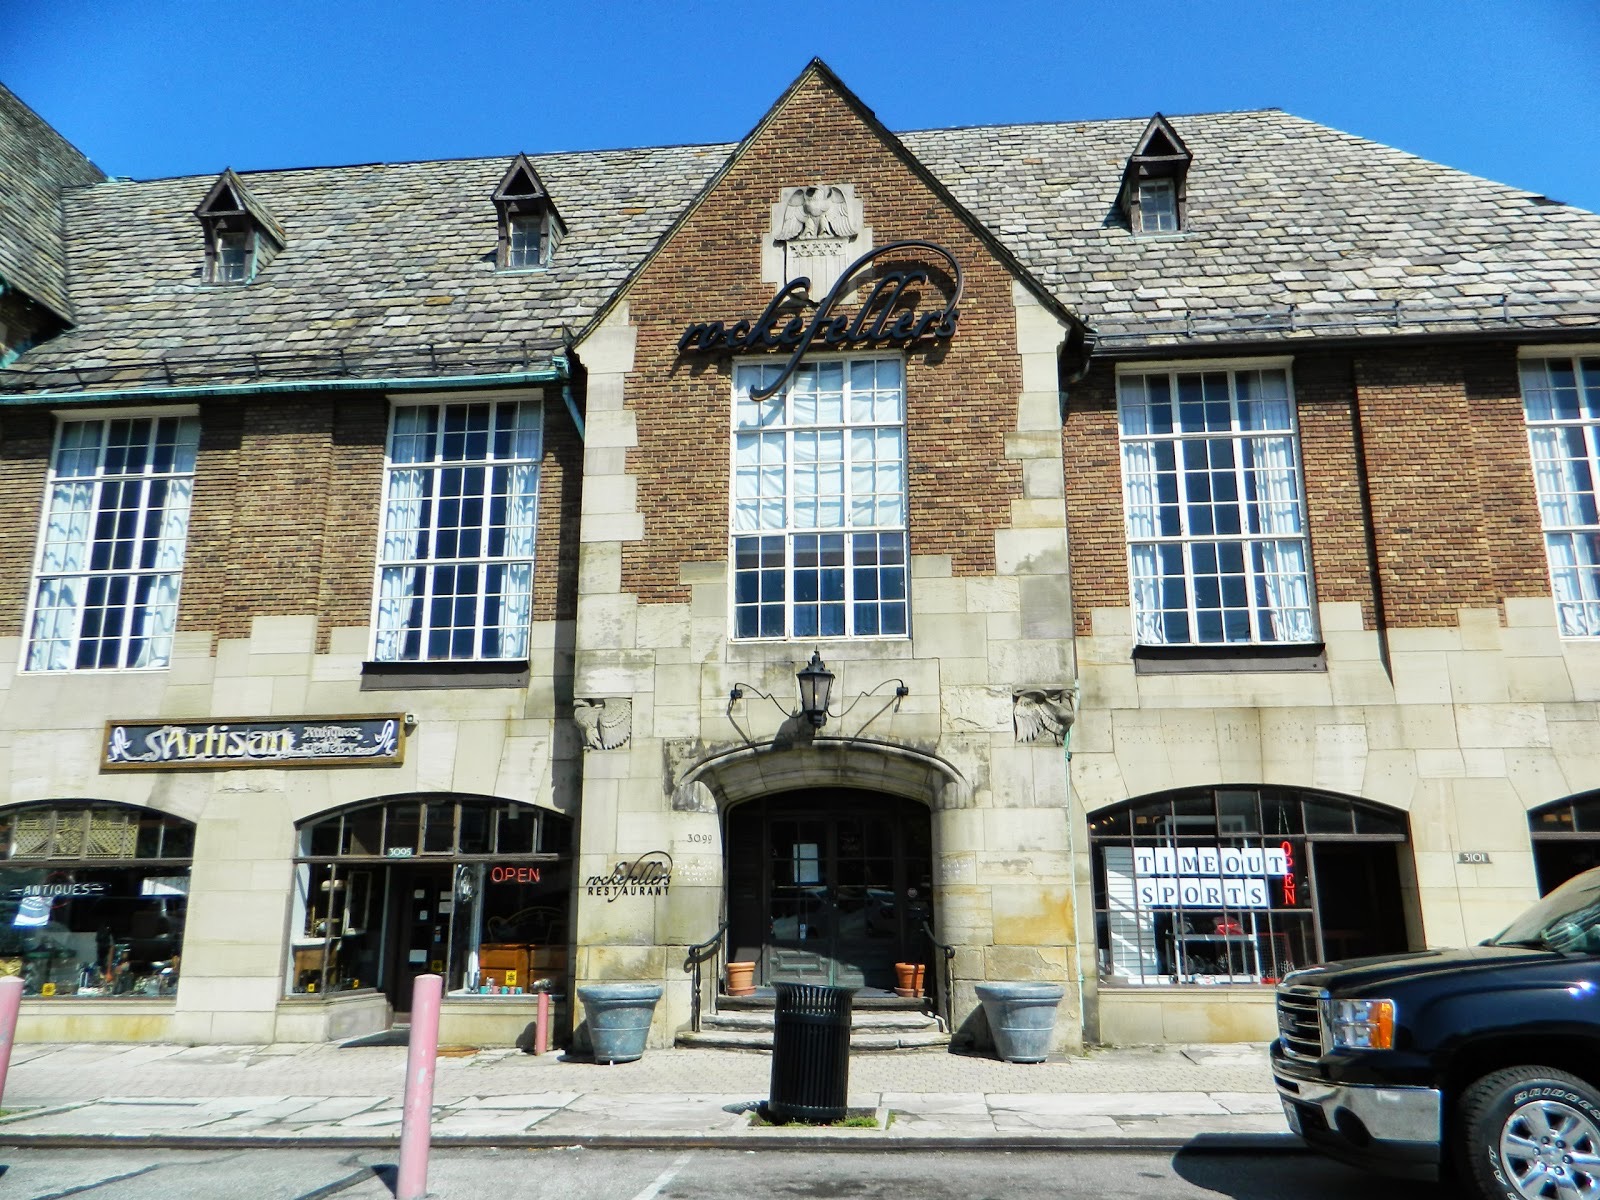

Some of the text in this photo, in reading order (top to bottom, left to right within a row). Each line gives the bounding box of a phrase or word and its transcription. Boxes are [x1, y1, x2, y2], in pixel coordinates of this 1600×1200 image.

[687, 833, 713, 844] 3099
[389, 847, 412, 857] 3095
[1464, 853, 1485, 862] 3101
[491, 866, 540, 883] OPEN
[23, 883, 90, 896] ANTIQUES
[587, 886, 669, 896] RESTAURANT
[1142, 886, 1262, 904] SPORTS
